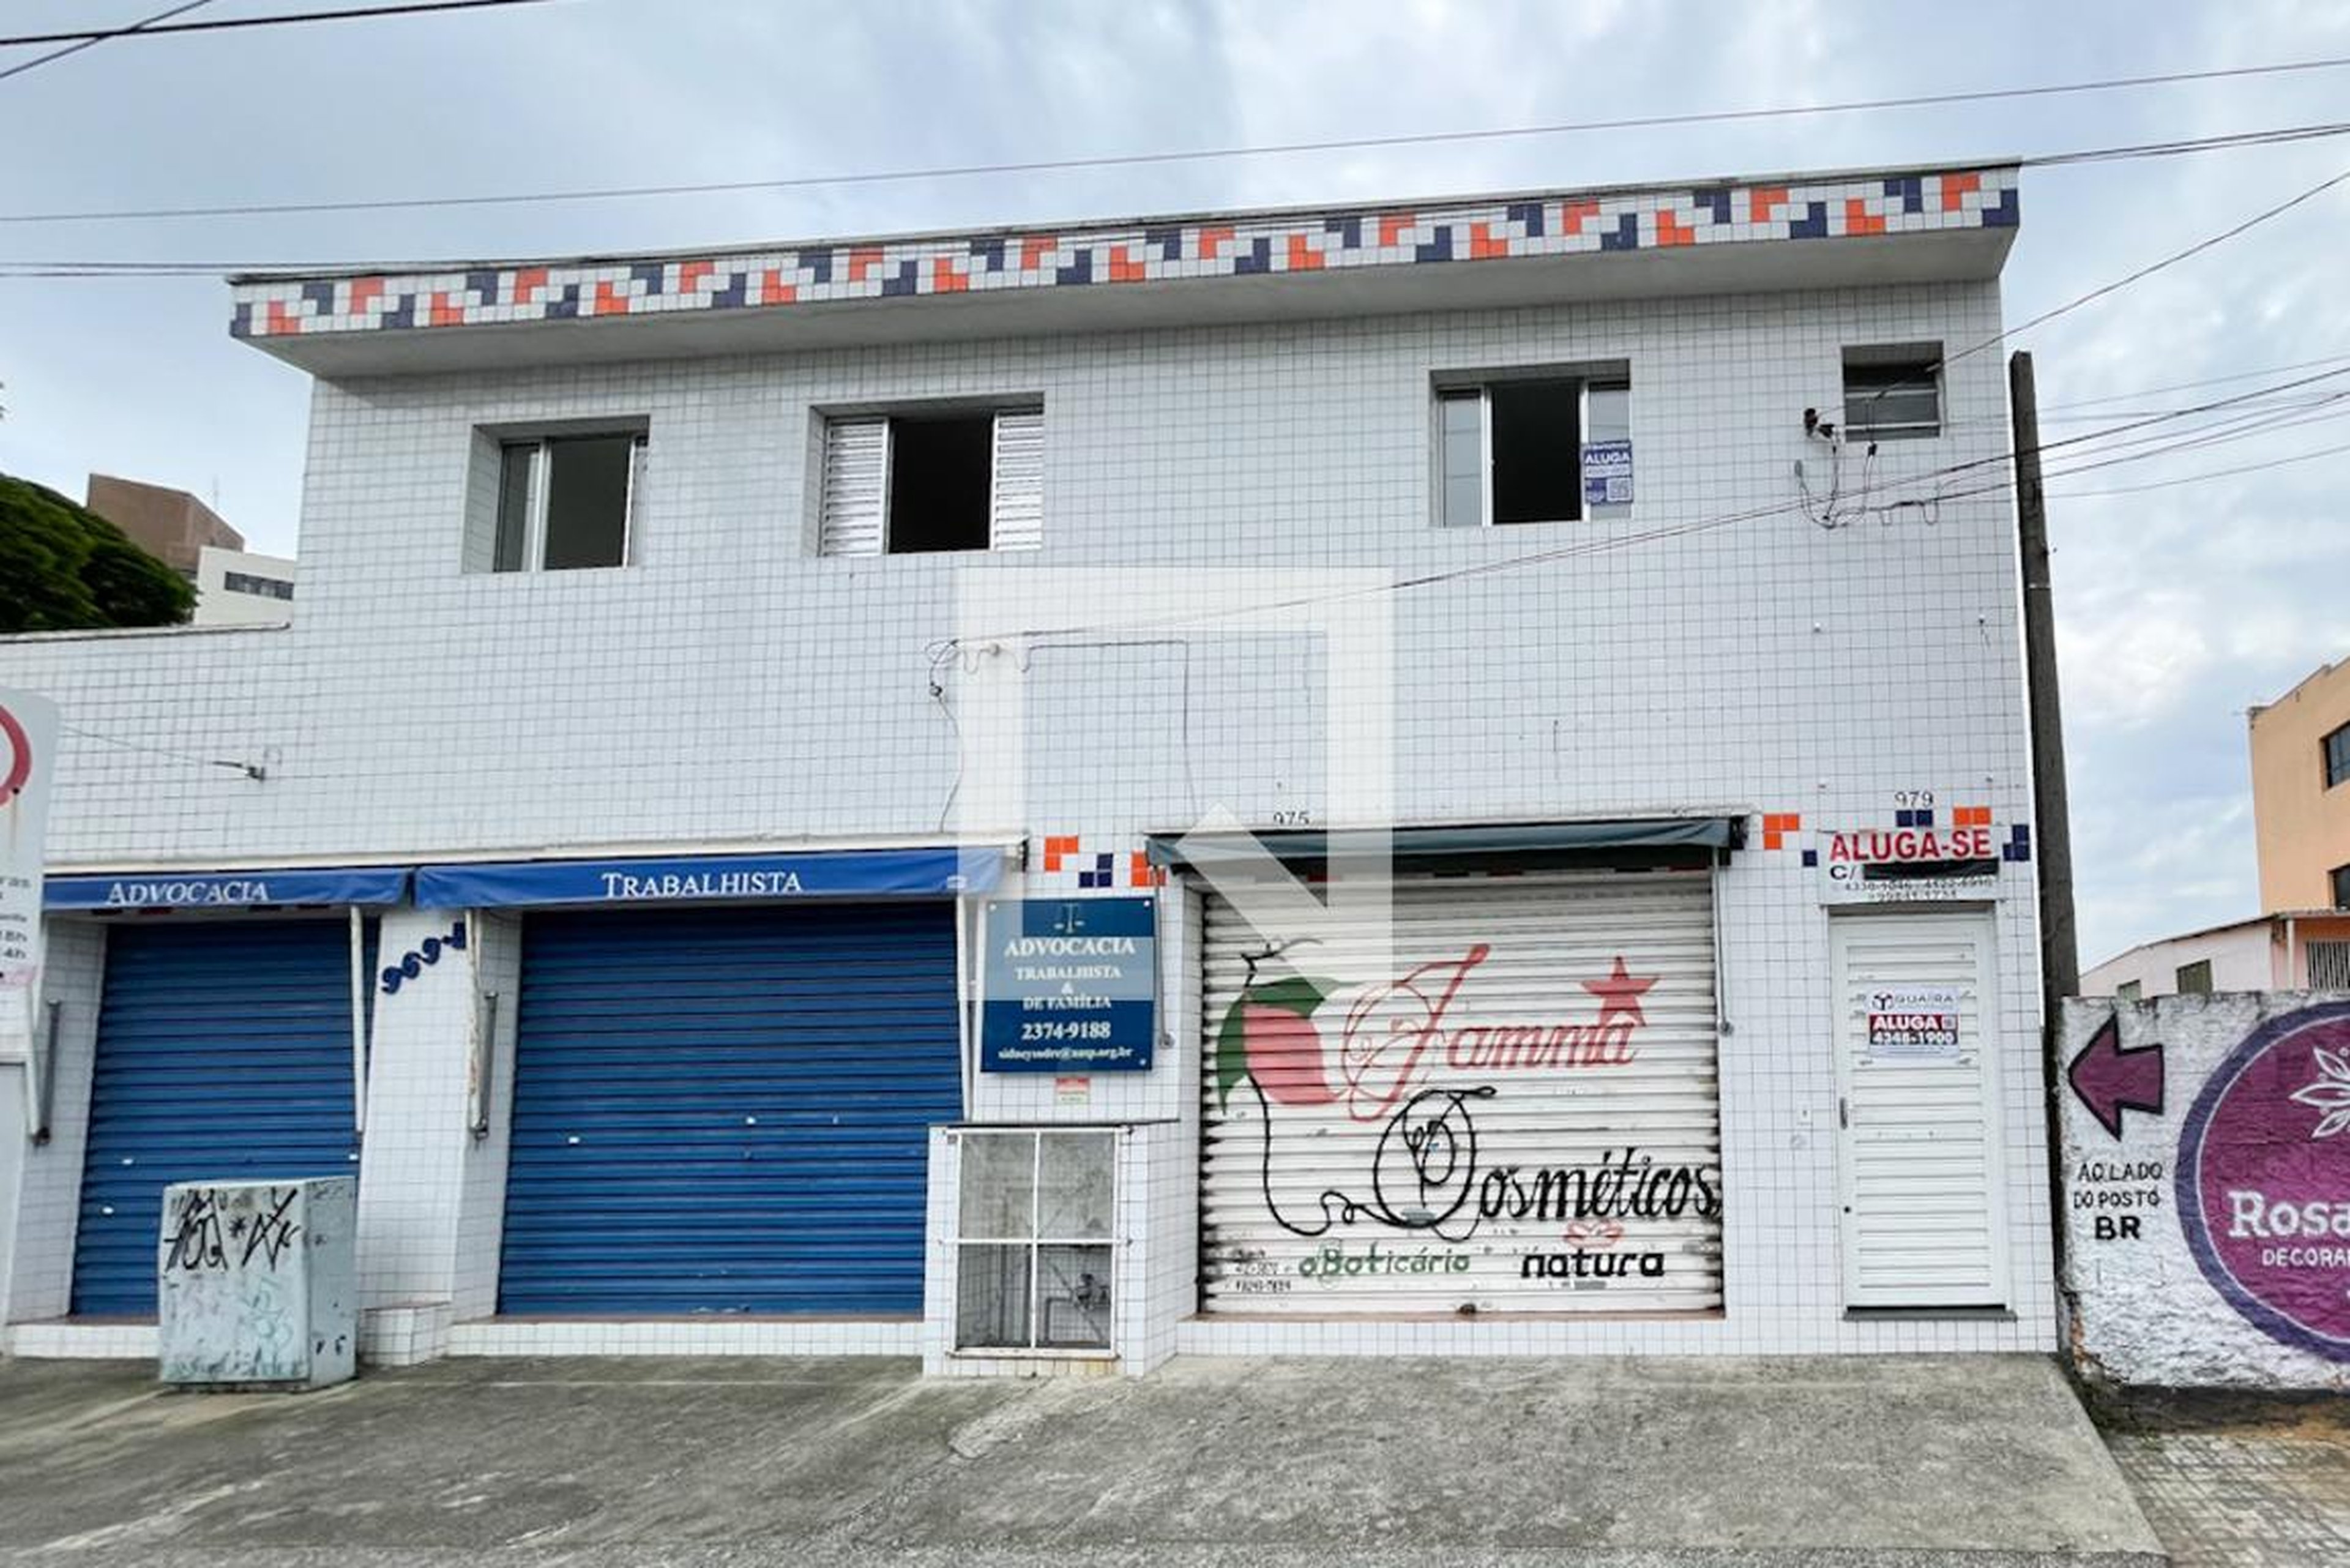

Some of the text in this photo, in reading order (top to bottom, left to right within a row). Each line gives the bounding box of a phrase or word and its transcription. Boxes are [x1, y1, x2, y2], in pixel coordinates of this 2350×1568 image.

[1585, 451, 1630, 465] ALUGA
[1894, 790, 1933, 807] 979
[1274, 811, 1309, 826] 975
[1829, 829, 1993, 862] ALUGA-SE
[106, 881, 270, 906] ADVOCACIA
[601, 871, 804, 900] TRABALHISTA
[1004, 937, 1136, 957] ADVOCACIA
[1014, 965, 1122, 981] TRABALHISTA
[1023, 993, 1112, 1010] DE FAMÍLIA
[1021, 1021, 1111, 1040] 2374-9188
[1872, 1015, 1940, 1031] ALUGA
[2077, 1162, 2163, 1182] AO LADO
[2073, 1187, 2161, 1209] DO POSTO
[2095, 1215, 2141, 1241] BR
[1520, 1248, 1666, 1279] natura
[2262, 1247, 2350, 1269] DECORA
